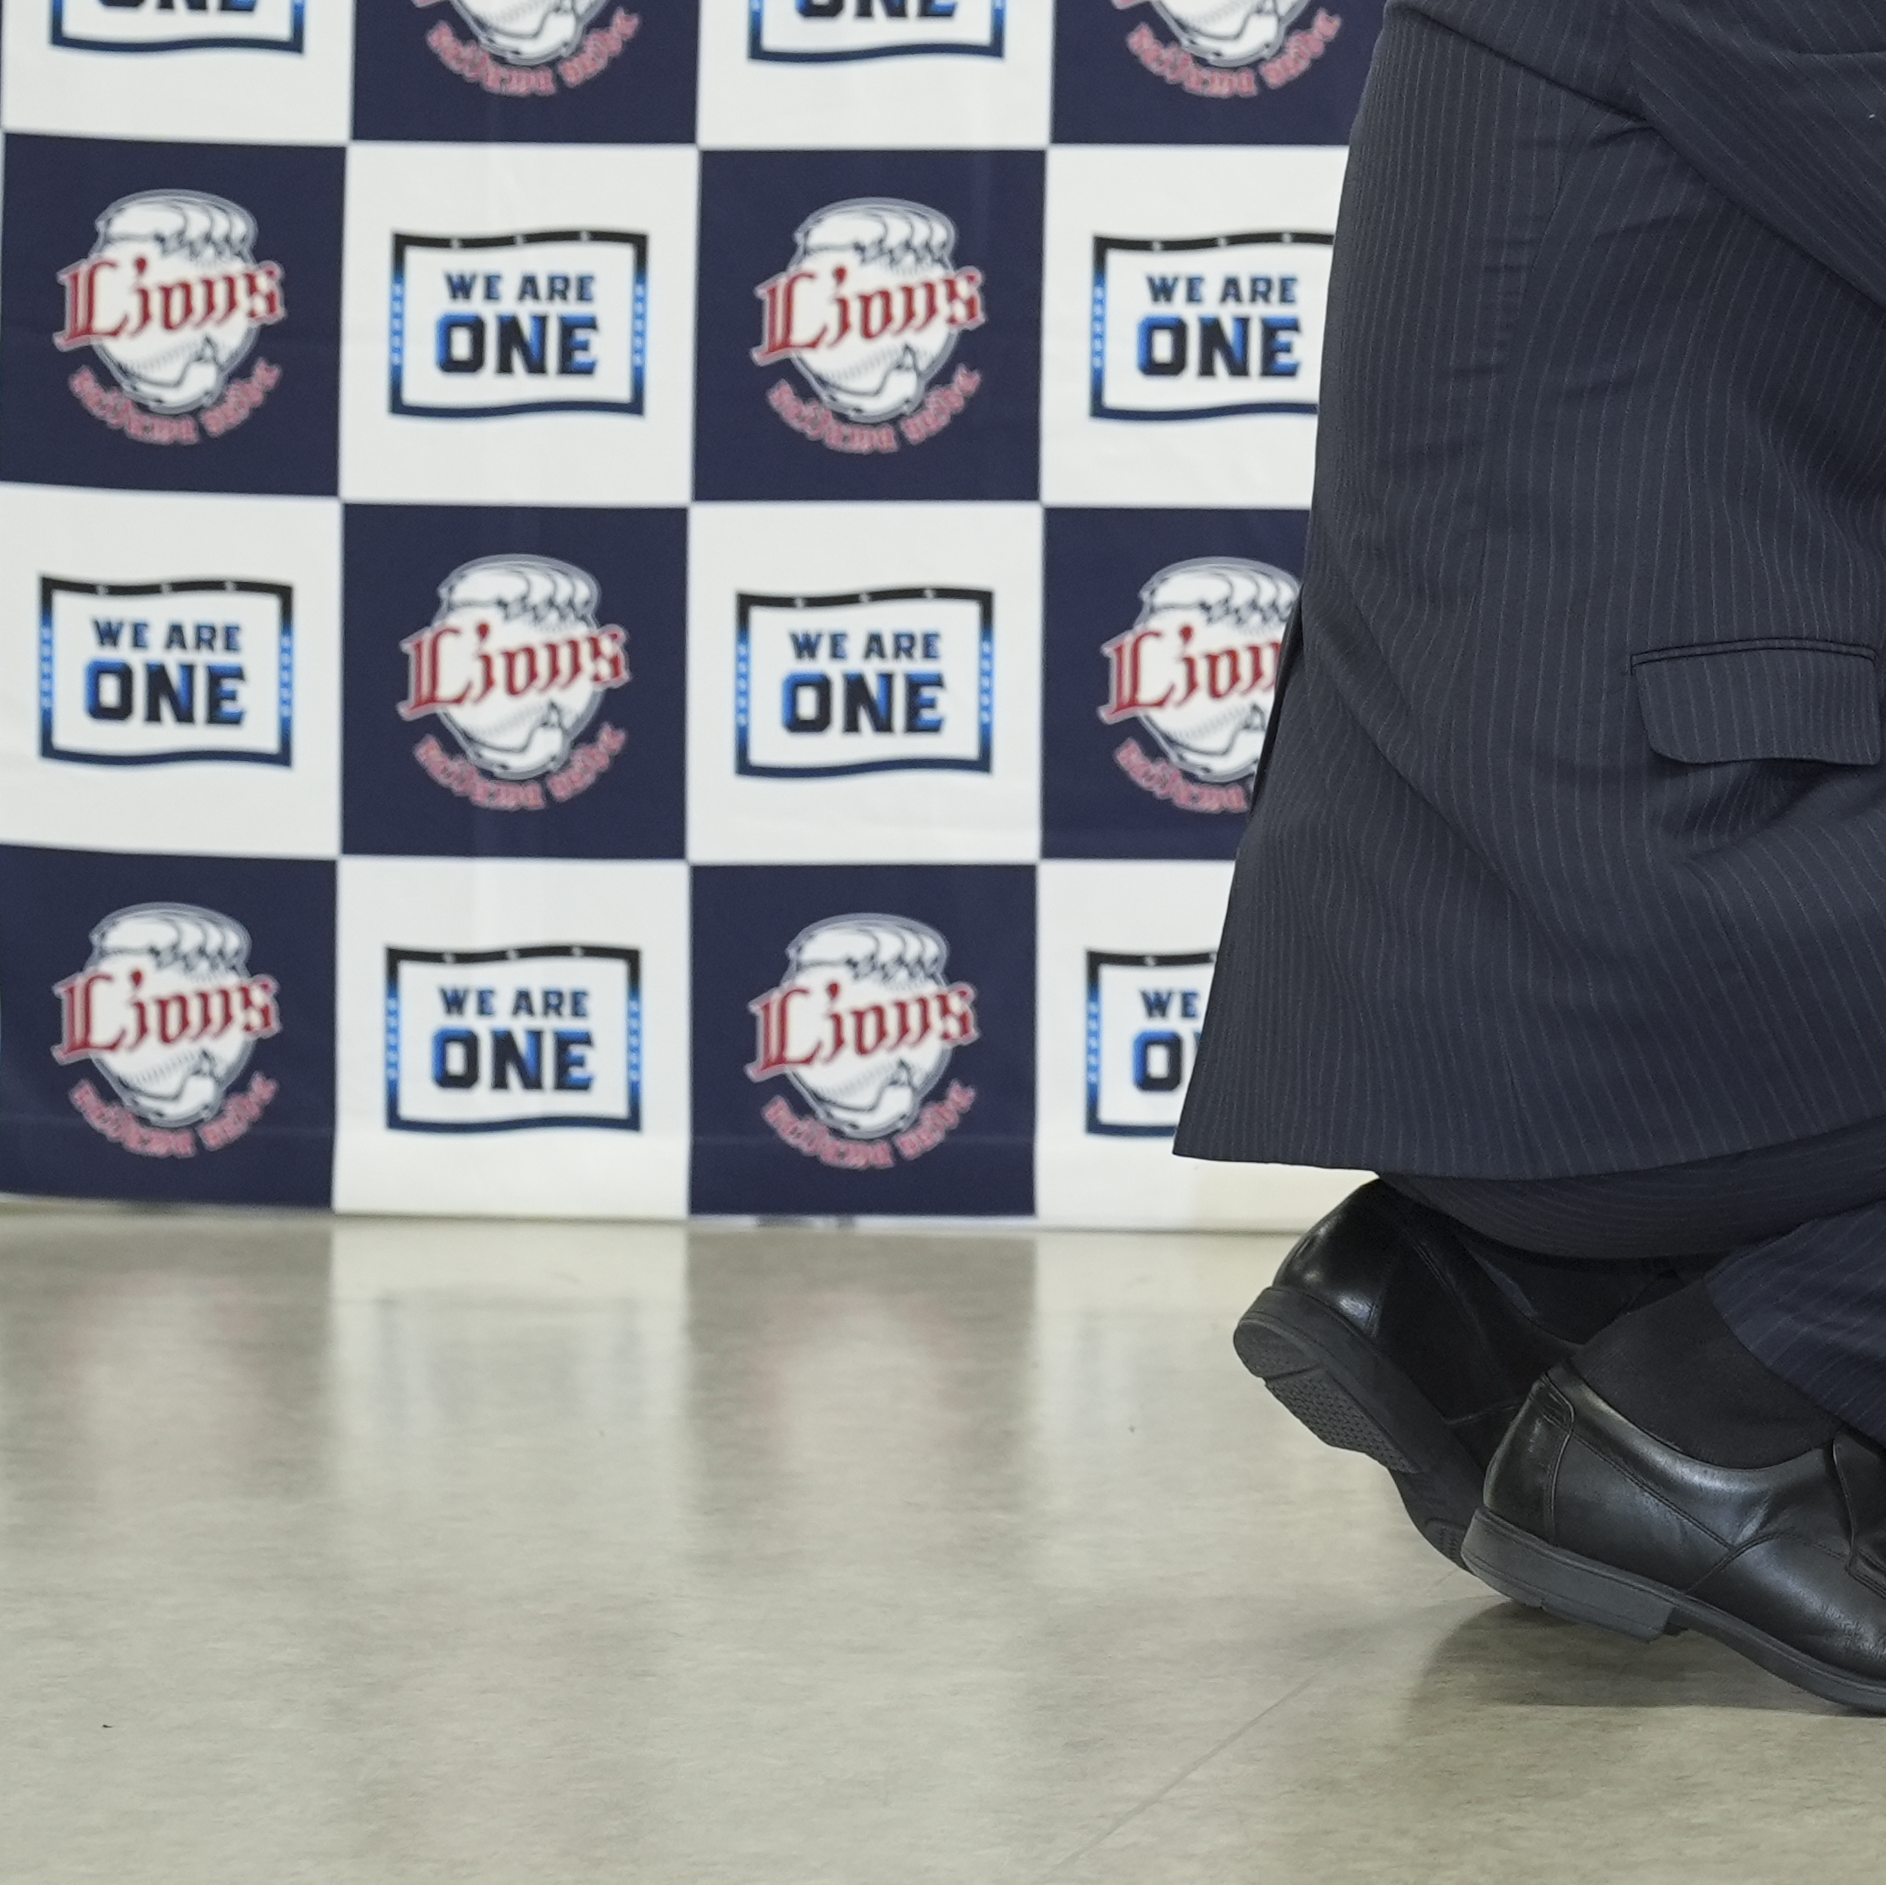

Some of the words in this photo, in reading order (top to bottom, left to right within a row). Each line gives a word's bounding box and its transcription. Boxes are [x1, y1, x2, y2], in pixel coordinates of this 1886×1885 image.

[63, 257, 281, 343] Lions
[761, 266, 981, 357] Lions
[93, 619, 148, 650] WE
[165, 622, 240, 653] ARE
[408, 622, 625, 711] Lions
[790, 631, 847, 660] WE
[863, 632, 940, 660] ARE
[85, 660, 245, 726] ONE
[782, 672, 945, 734] ONE
[62, 970, 275, 1055] Lions
[440, 988, 495, 1017] WE
[512, 989, 588, 1019] ARE
[758, 982, 974, 1073] Lions
[432, 1027, 593, 1092] ONE
